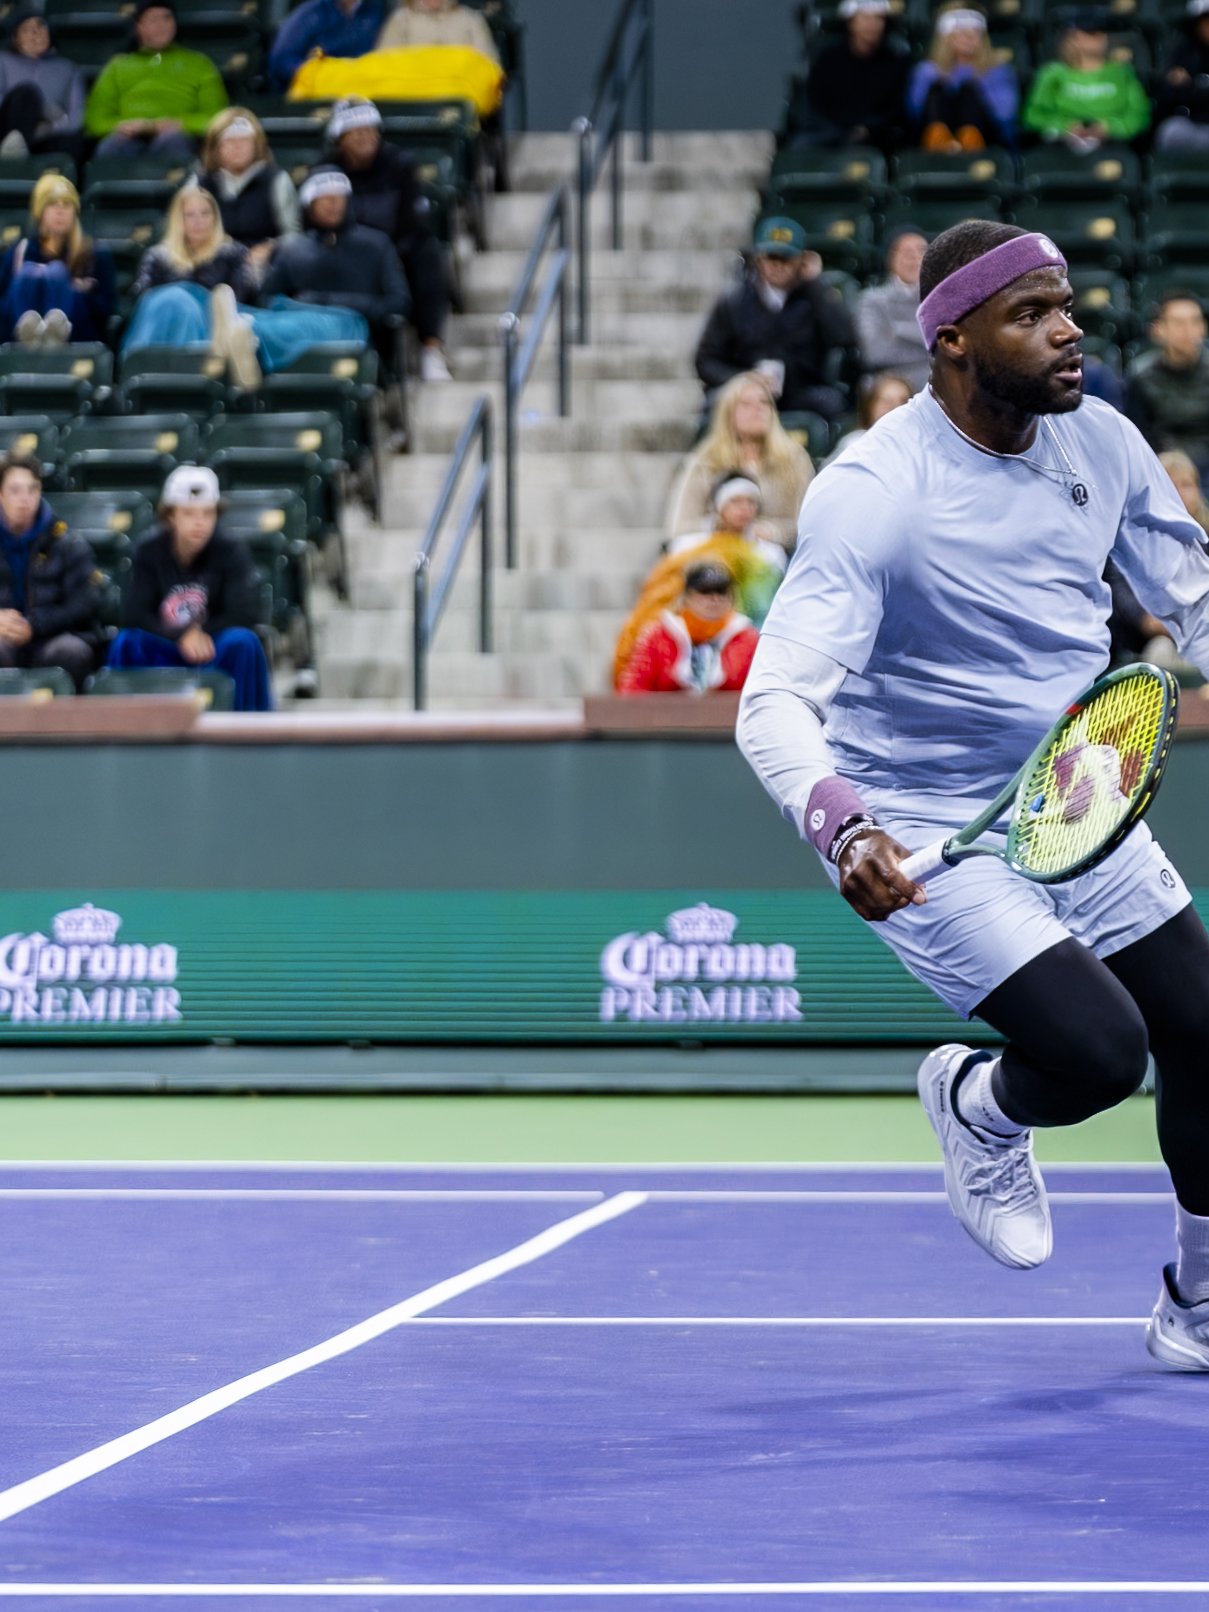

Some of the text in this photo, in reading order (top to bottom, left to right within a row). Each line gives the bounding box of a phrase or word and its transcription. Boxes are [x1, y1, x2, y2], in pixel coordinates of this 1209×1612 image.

[0, 931, 178, 988] Corona
[601, 931, 798, 988] Corona
[601, 985, 805, 1022] PREMIER
